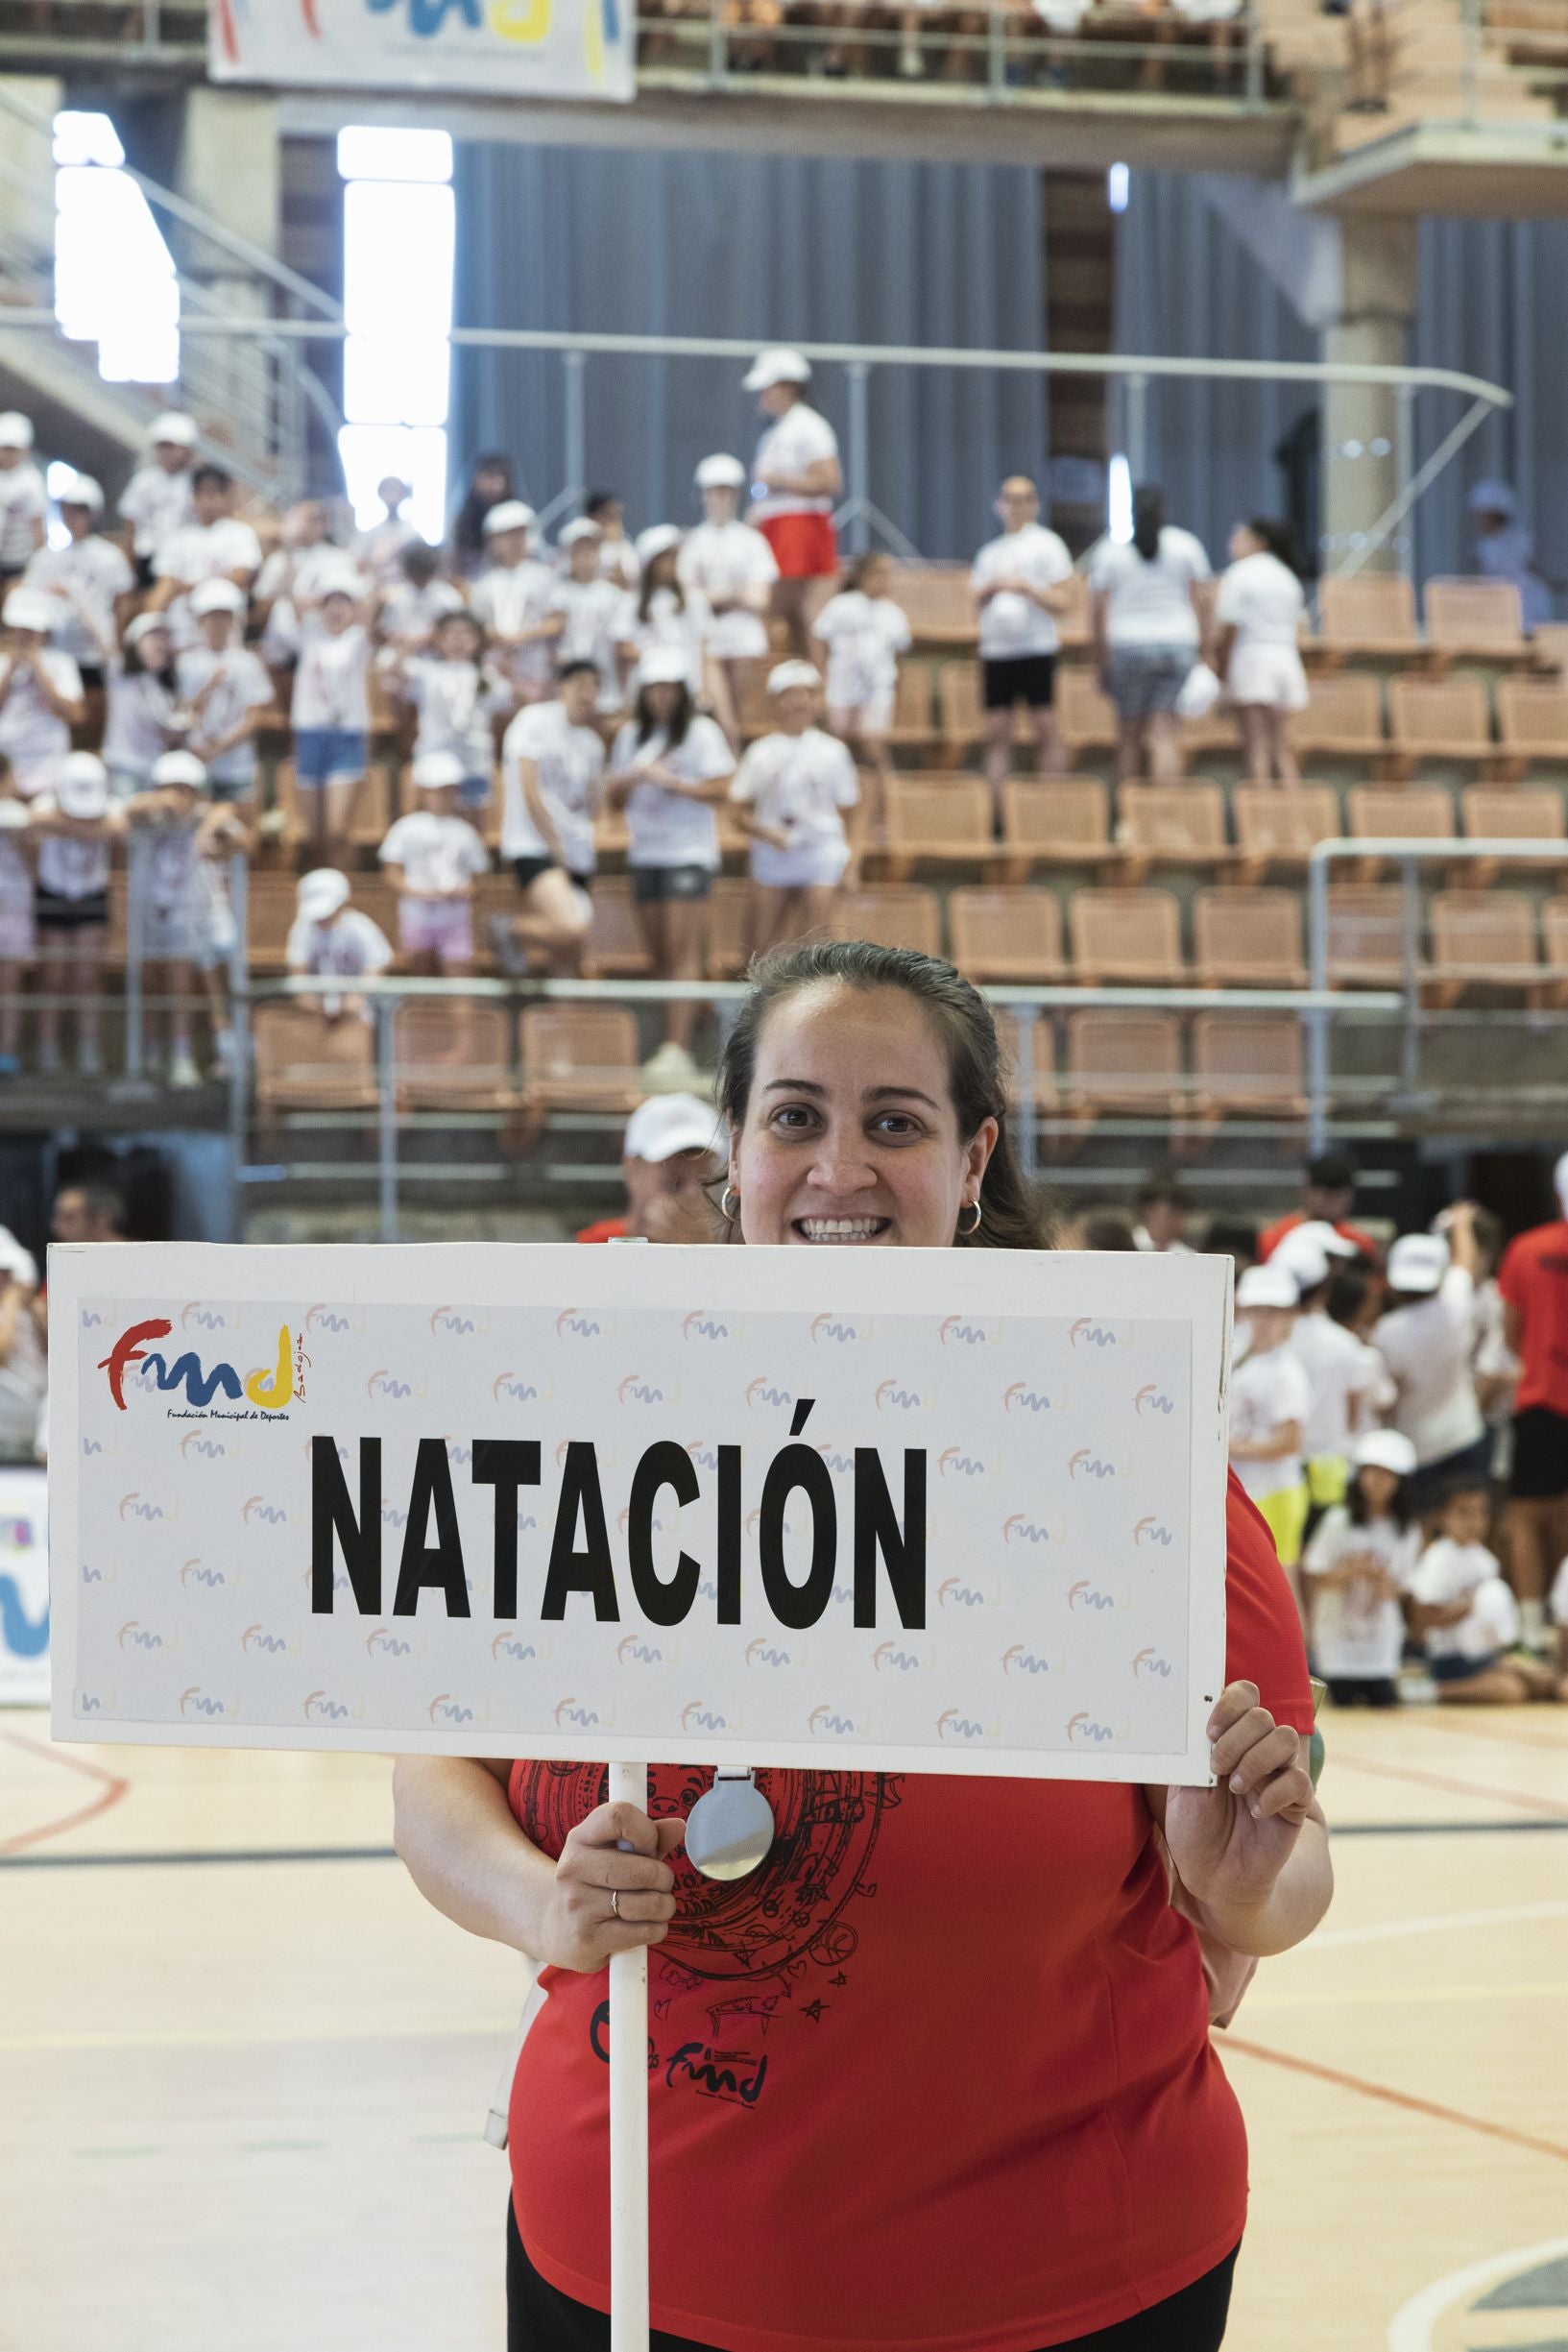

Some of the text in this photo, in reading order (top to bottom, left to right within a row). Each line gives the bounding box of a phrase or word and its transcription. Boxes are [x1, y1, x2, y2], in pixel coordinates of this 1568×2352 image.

[97, 1319, 293, 1411] fmd
[166, 1408, 290, 1423] Fundación Municipal de Deportes
[311, 1398, 928, 1631] NATACIÓN
